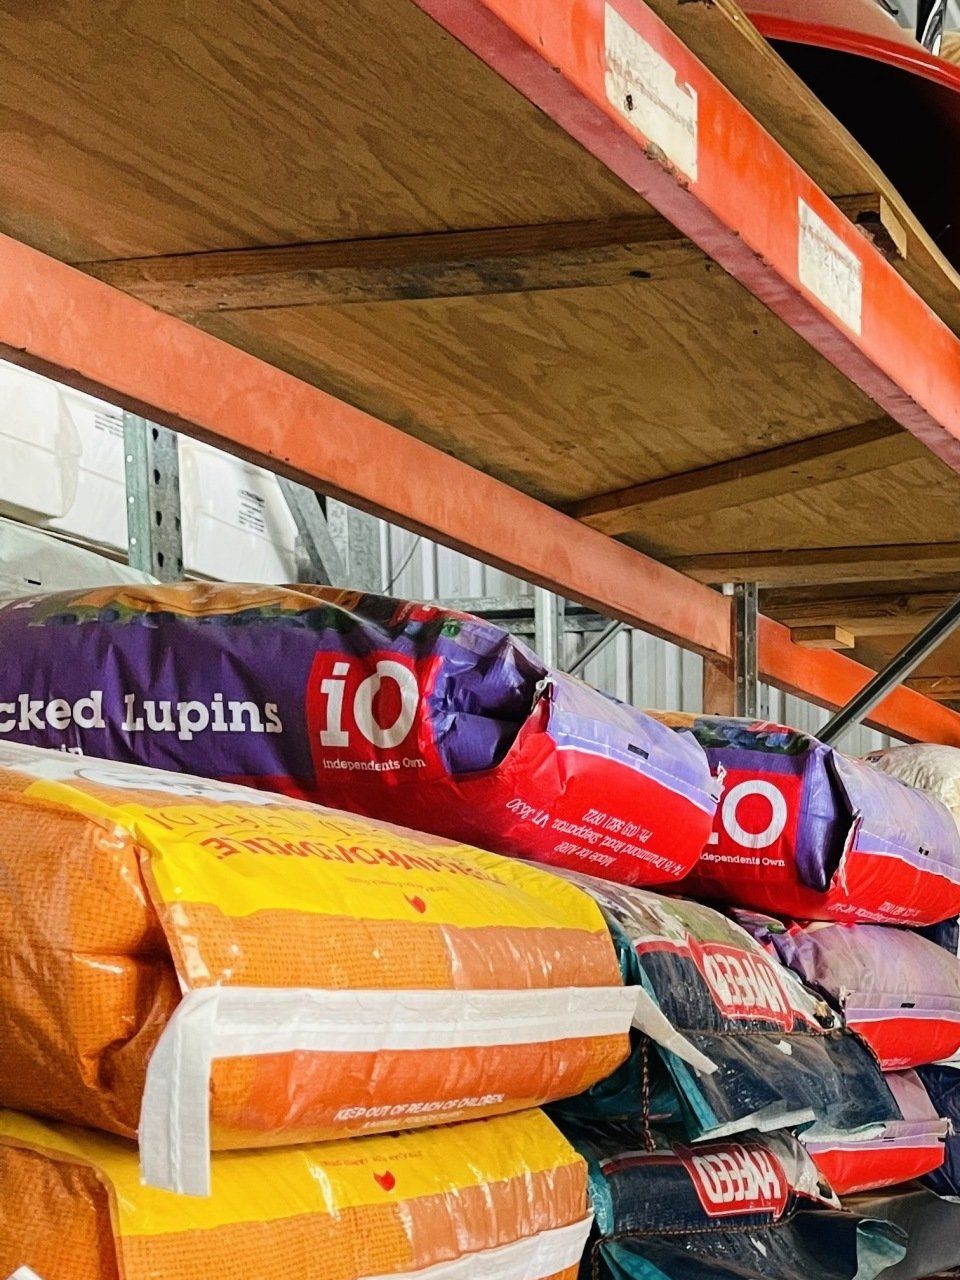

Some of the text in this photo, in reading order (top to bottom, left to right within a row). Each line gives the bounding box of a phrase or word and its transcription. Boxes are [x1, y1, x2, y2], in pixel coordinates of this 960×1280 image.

[320, 660, 420, 749] iO
[121, 693, 283, 741] Lupins
[402, 757, 426, 768] Own
[505, 798, 536, 820] 3630
[762, 857, 786, 867] Own
[333, 1107, 366, 1121] KEEP
[365, 1105, 390, 1118] OUT
[390, 1104, 406, 1115] OF
[405, 1101, 442, 1114] REACH
[442, 1099, 459, 1110] OF
